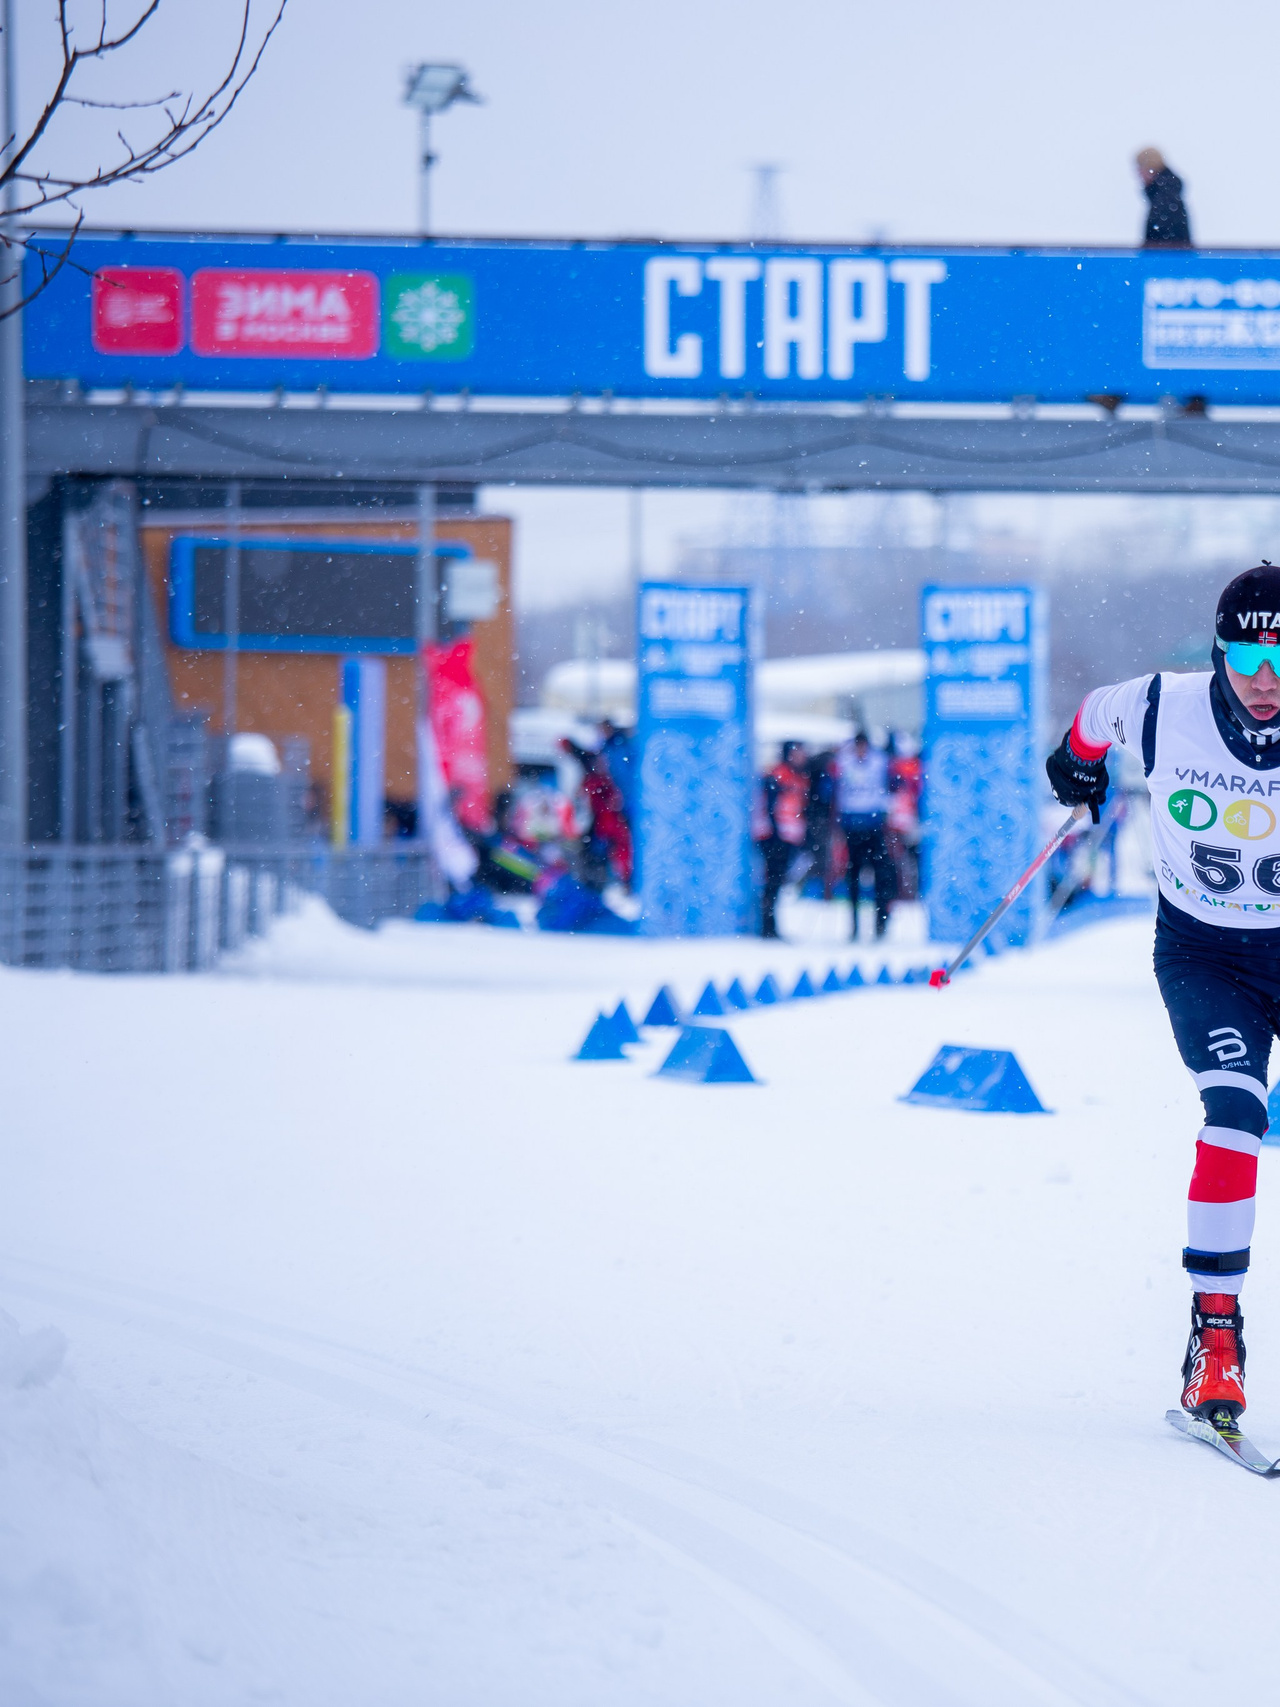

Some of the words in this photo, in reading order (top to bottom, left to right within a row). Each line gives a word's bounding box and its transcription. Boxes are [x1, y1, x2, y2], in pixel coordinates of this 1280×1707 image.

[216, 284, 352, 321] ЗИМА
[645, 256, 946, 381] СТАРТ
[1206, 1317, 1233, 1325] alpina
